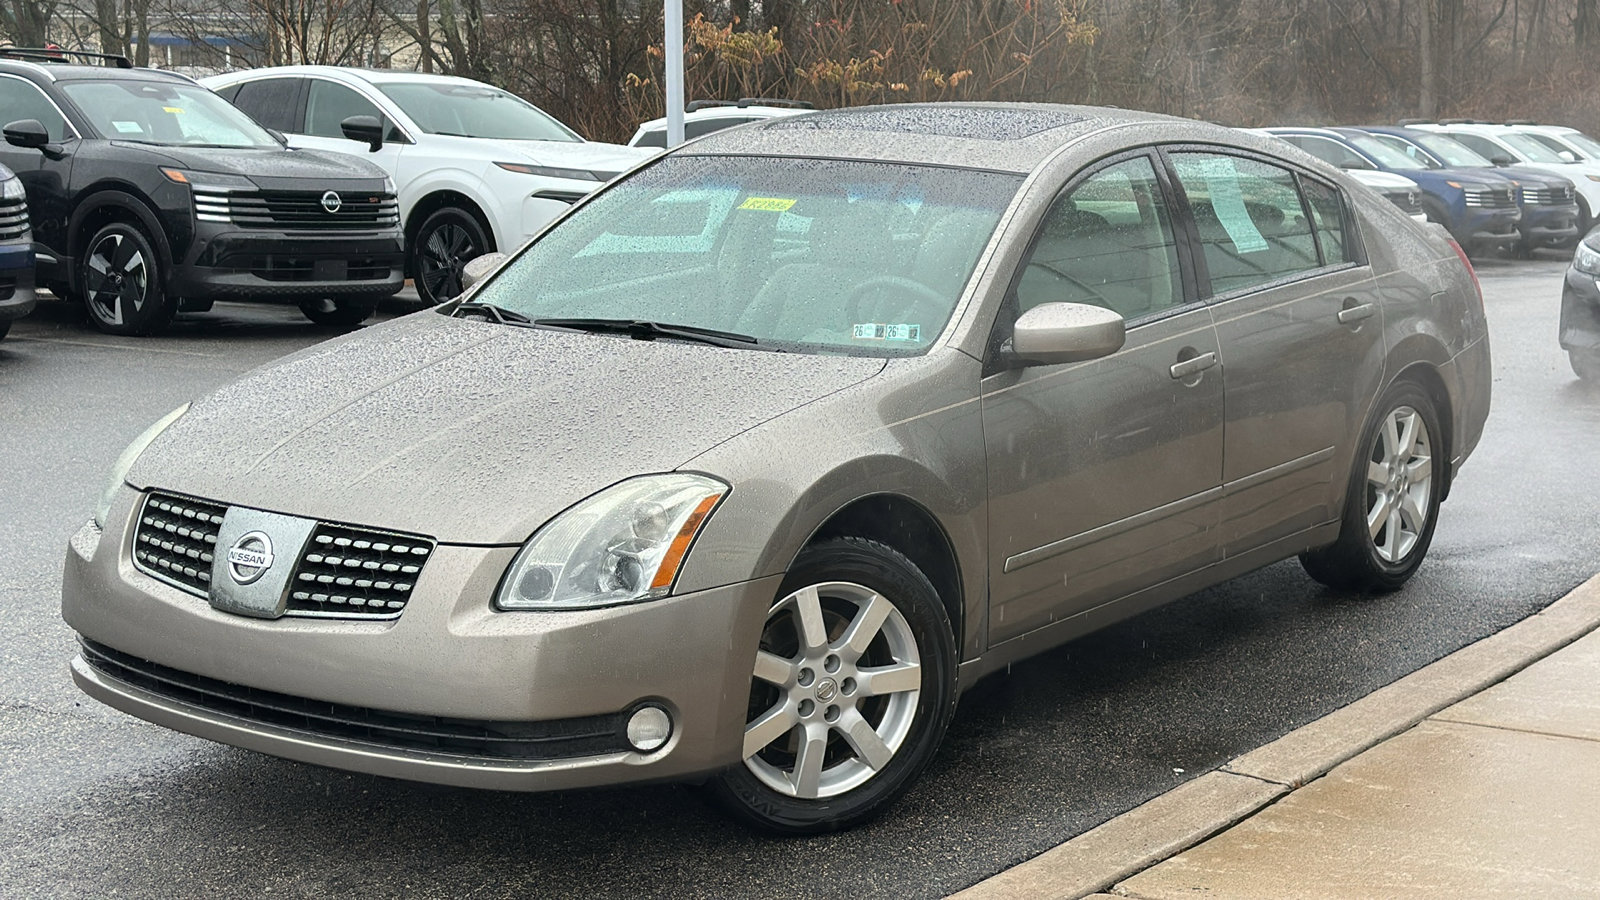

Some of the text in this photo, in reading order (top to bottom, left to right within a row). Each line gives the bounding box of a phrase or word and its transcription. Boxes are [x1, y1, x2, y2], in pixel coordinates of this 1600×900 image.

[854, 325, 863, 337] 26
[888, 326, 896, 337] 26
[229, 551, 265, 565] NISSAN
